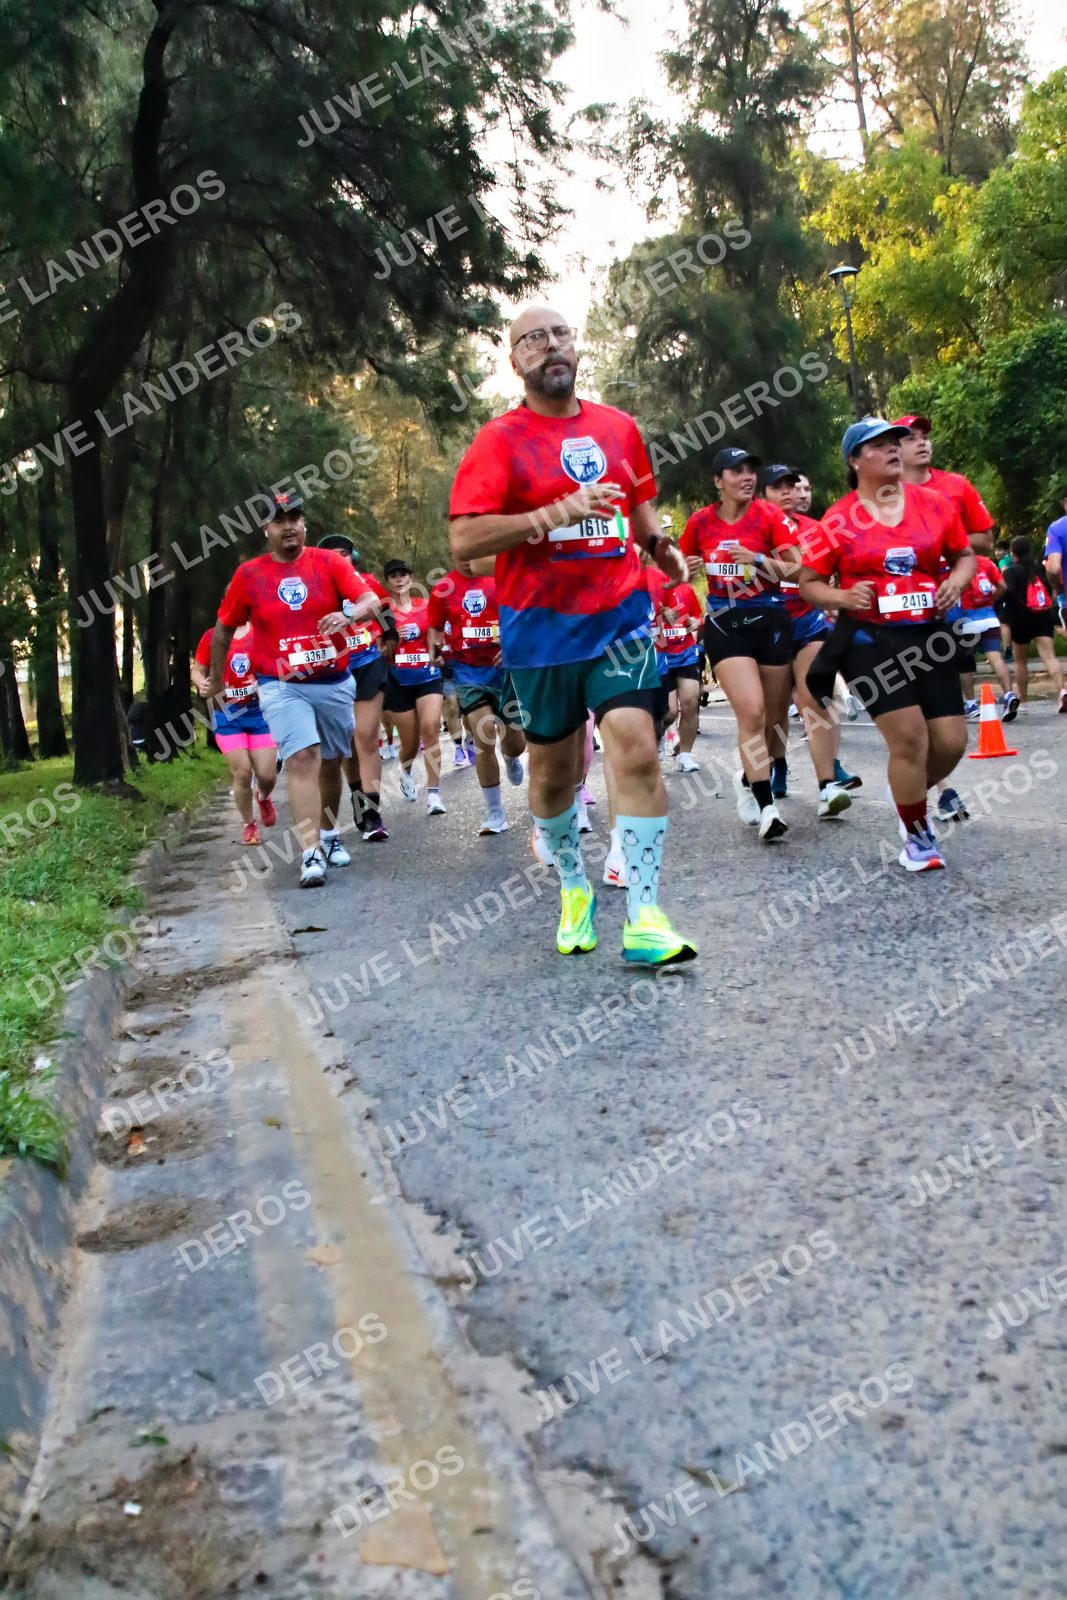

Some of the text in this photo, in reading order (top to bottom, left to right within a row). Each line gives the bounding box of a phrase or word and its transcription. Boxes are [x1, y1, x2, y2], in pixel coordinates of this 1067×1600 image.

[580, 519, 610, 537] 1616
[718, 564, 738, 575] 1601
[902, 594, 927, 609] 2419
[474, 628, 491, 637] 1748
[232, 688, 248, 696] 1456
